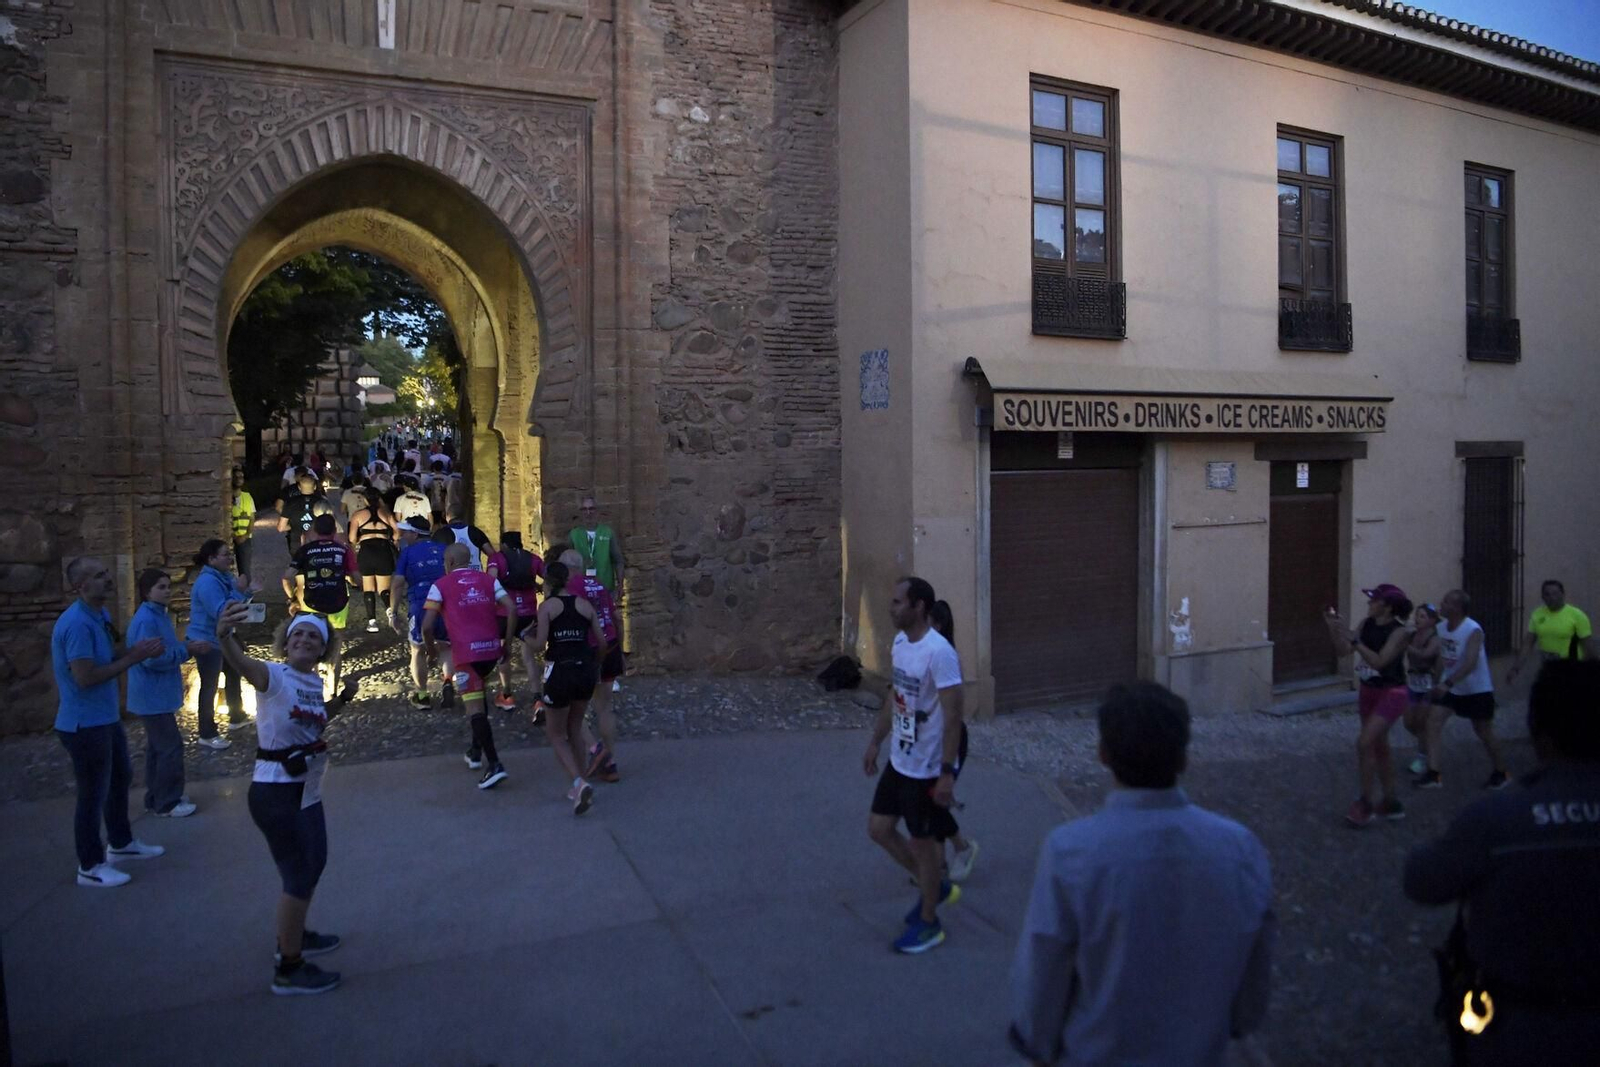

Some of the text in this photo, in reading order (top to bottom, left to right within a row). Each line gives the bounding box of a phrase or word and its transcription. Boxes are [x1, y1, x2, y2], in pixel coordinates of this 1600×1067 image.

[1003, 399, 1386, 429] SOUVENIRS DRINKS ICE CREAMS SNACKS
[1532, 801, 1600, 825] SECU
